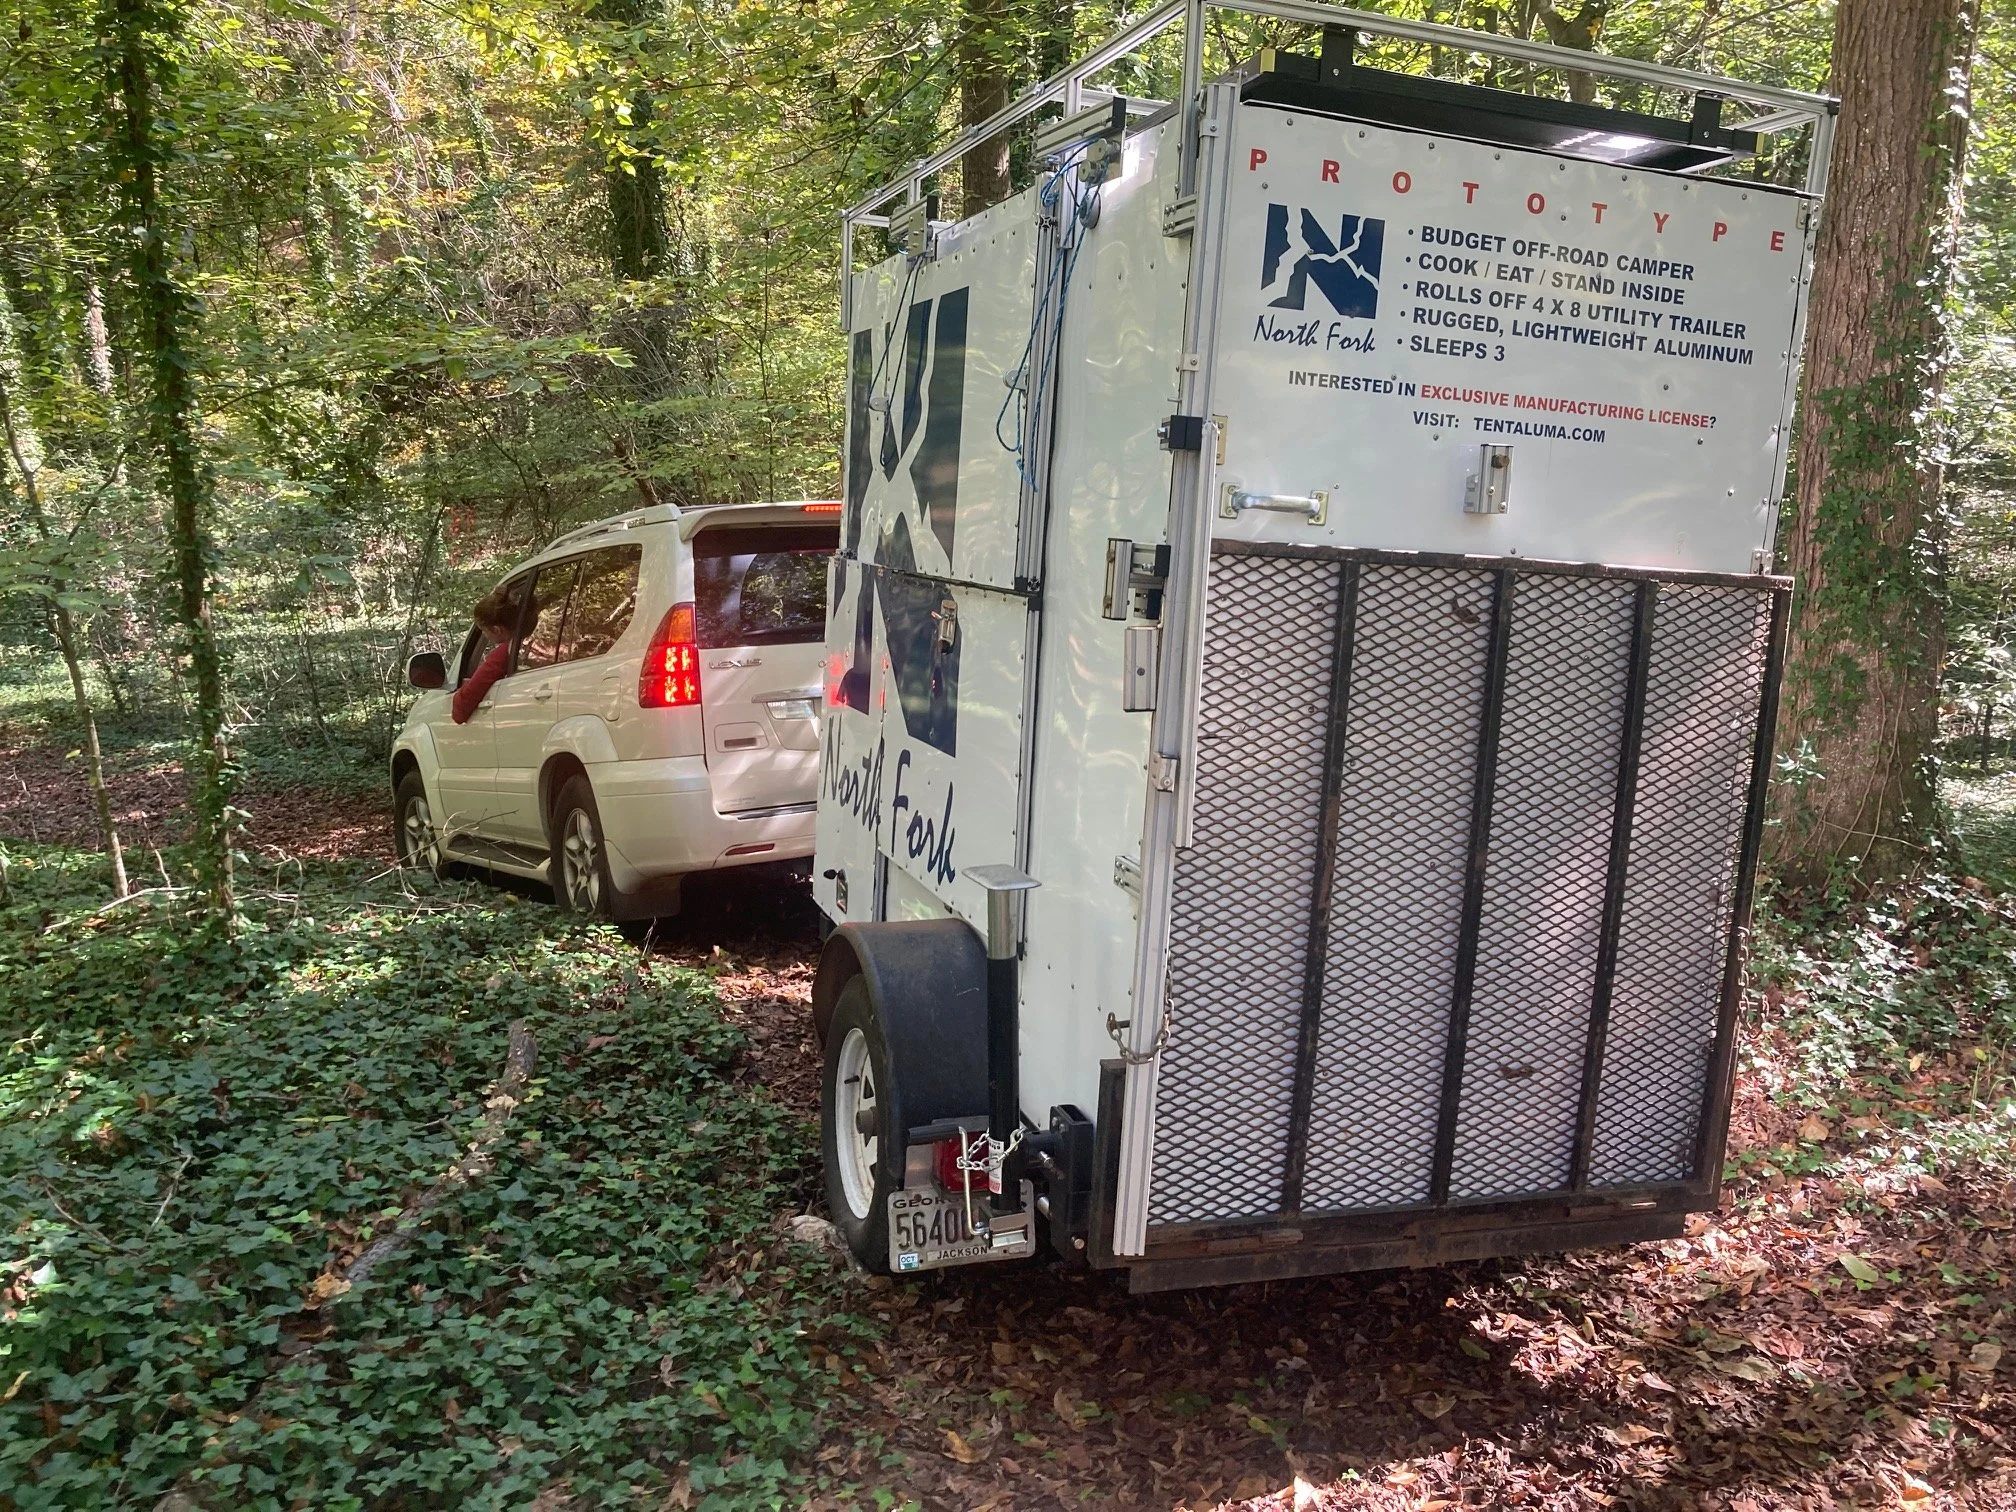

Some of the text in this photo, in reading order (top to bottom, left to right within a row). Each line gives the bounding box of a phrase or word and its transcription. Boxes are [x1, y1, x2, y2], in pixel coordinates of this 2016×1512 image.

[1418, 253, 1479, 277] COOK
[1496, 264, 1535, 284] EAT
[1551, 271, 1615, 295] STAND
[1621, 282, 1685, 306] INSIDE
[1421, 226, 1694, 281] BUDGET OFF-ROAD CAMPER
[1253, 314, 1376, 353] North Fork
[1413, 307, 1754, 365] RUGGED, LIGHTWEIGHT ALUMINUM
[1416, 281, 1482, 304] ROLLS
[1489, 291, 1527, 310] OFF
[1532, 297, 1544, 314] 4
[1570, 301, 1581, 318] 8
[1587, 305, 1664, 329] UTILITY
[1669, 314, 1746, 340] TRAILER
[1410, 335, 1505, 361] SLEEPS 3
[1288, 370, 1717, 429] INTERESTED IN EXCLUSIVE MANUFACTURING LICENSE?
[1413, 411, 1606, 443] VISIT: TENTALUMA.COM
[823, 715, 956, 885] North Fork
[900, 1255, 916, 1263] OCT
[937, 1246, 988, 1260] JACKSON
